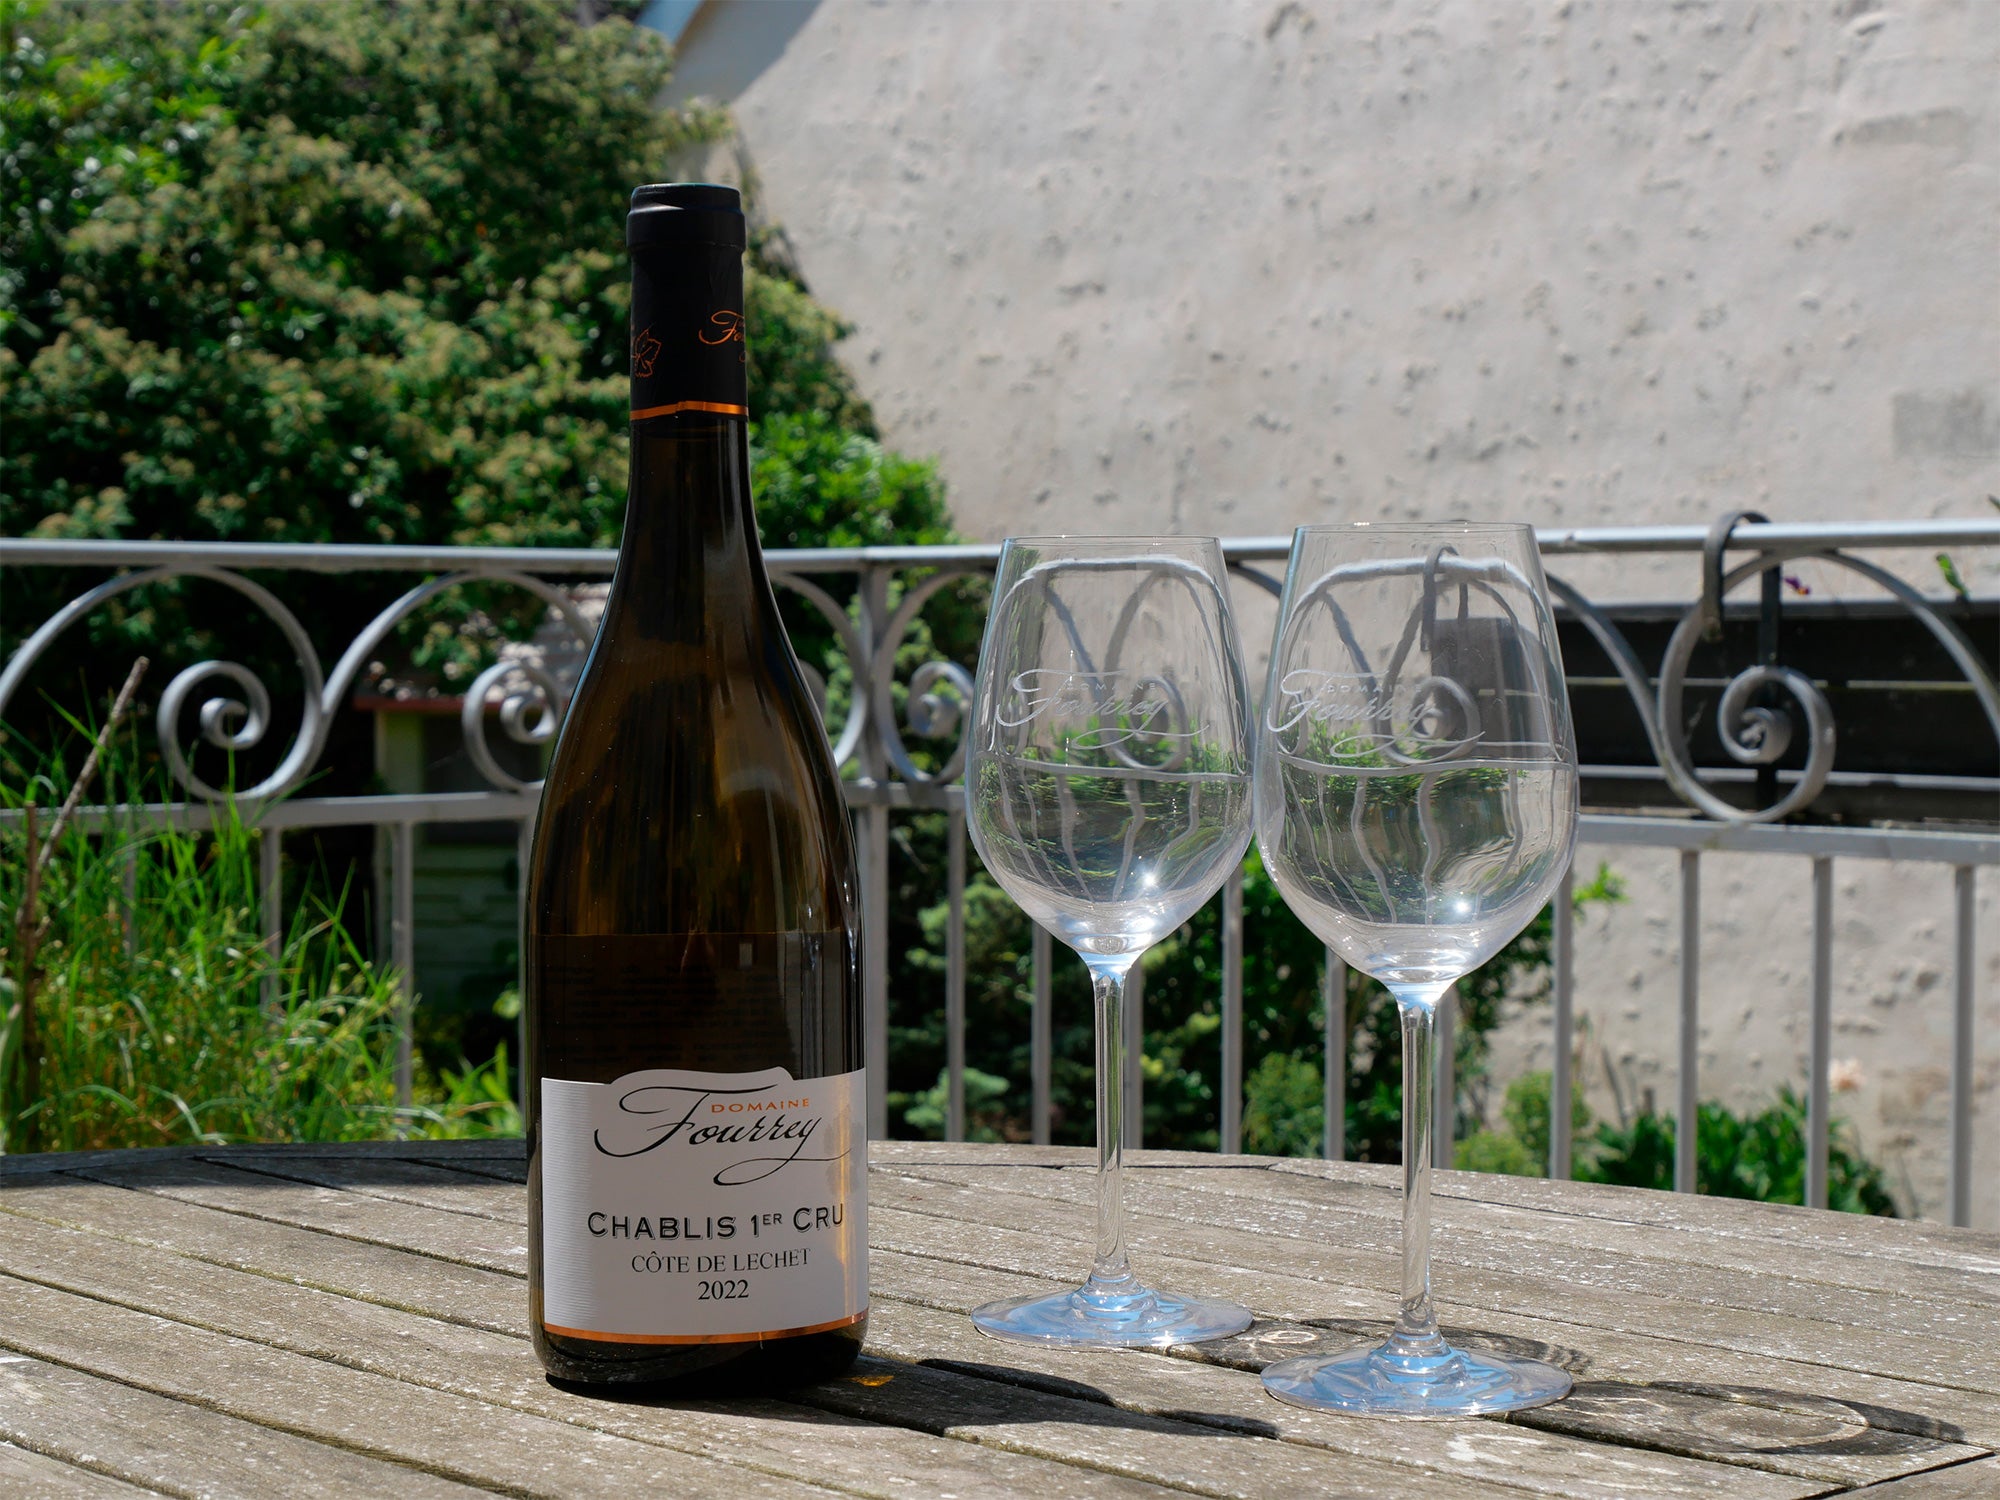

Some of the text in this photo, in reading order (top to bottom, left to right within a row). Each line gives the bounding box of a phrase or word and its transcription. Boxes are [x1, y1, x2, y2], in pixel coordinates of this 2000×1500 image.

[1065, 682, 1156, 691] DOMNE
[711, 1098, 810, 1113] DOMAINE
[593, 1084, 852, 1186] Fourrey
[588, 1211, 737, 1240] CHABLIS
[793, 1203, 844, 1232] CRU
[631, 1248, 811, 1273] CÔTE DE LECHET
[697, 1279, 750, 1300] 2022
